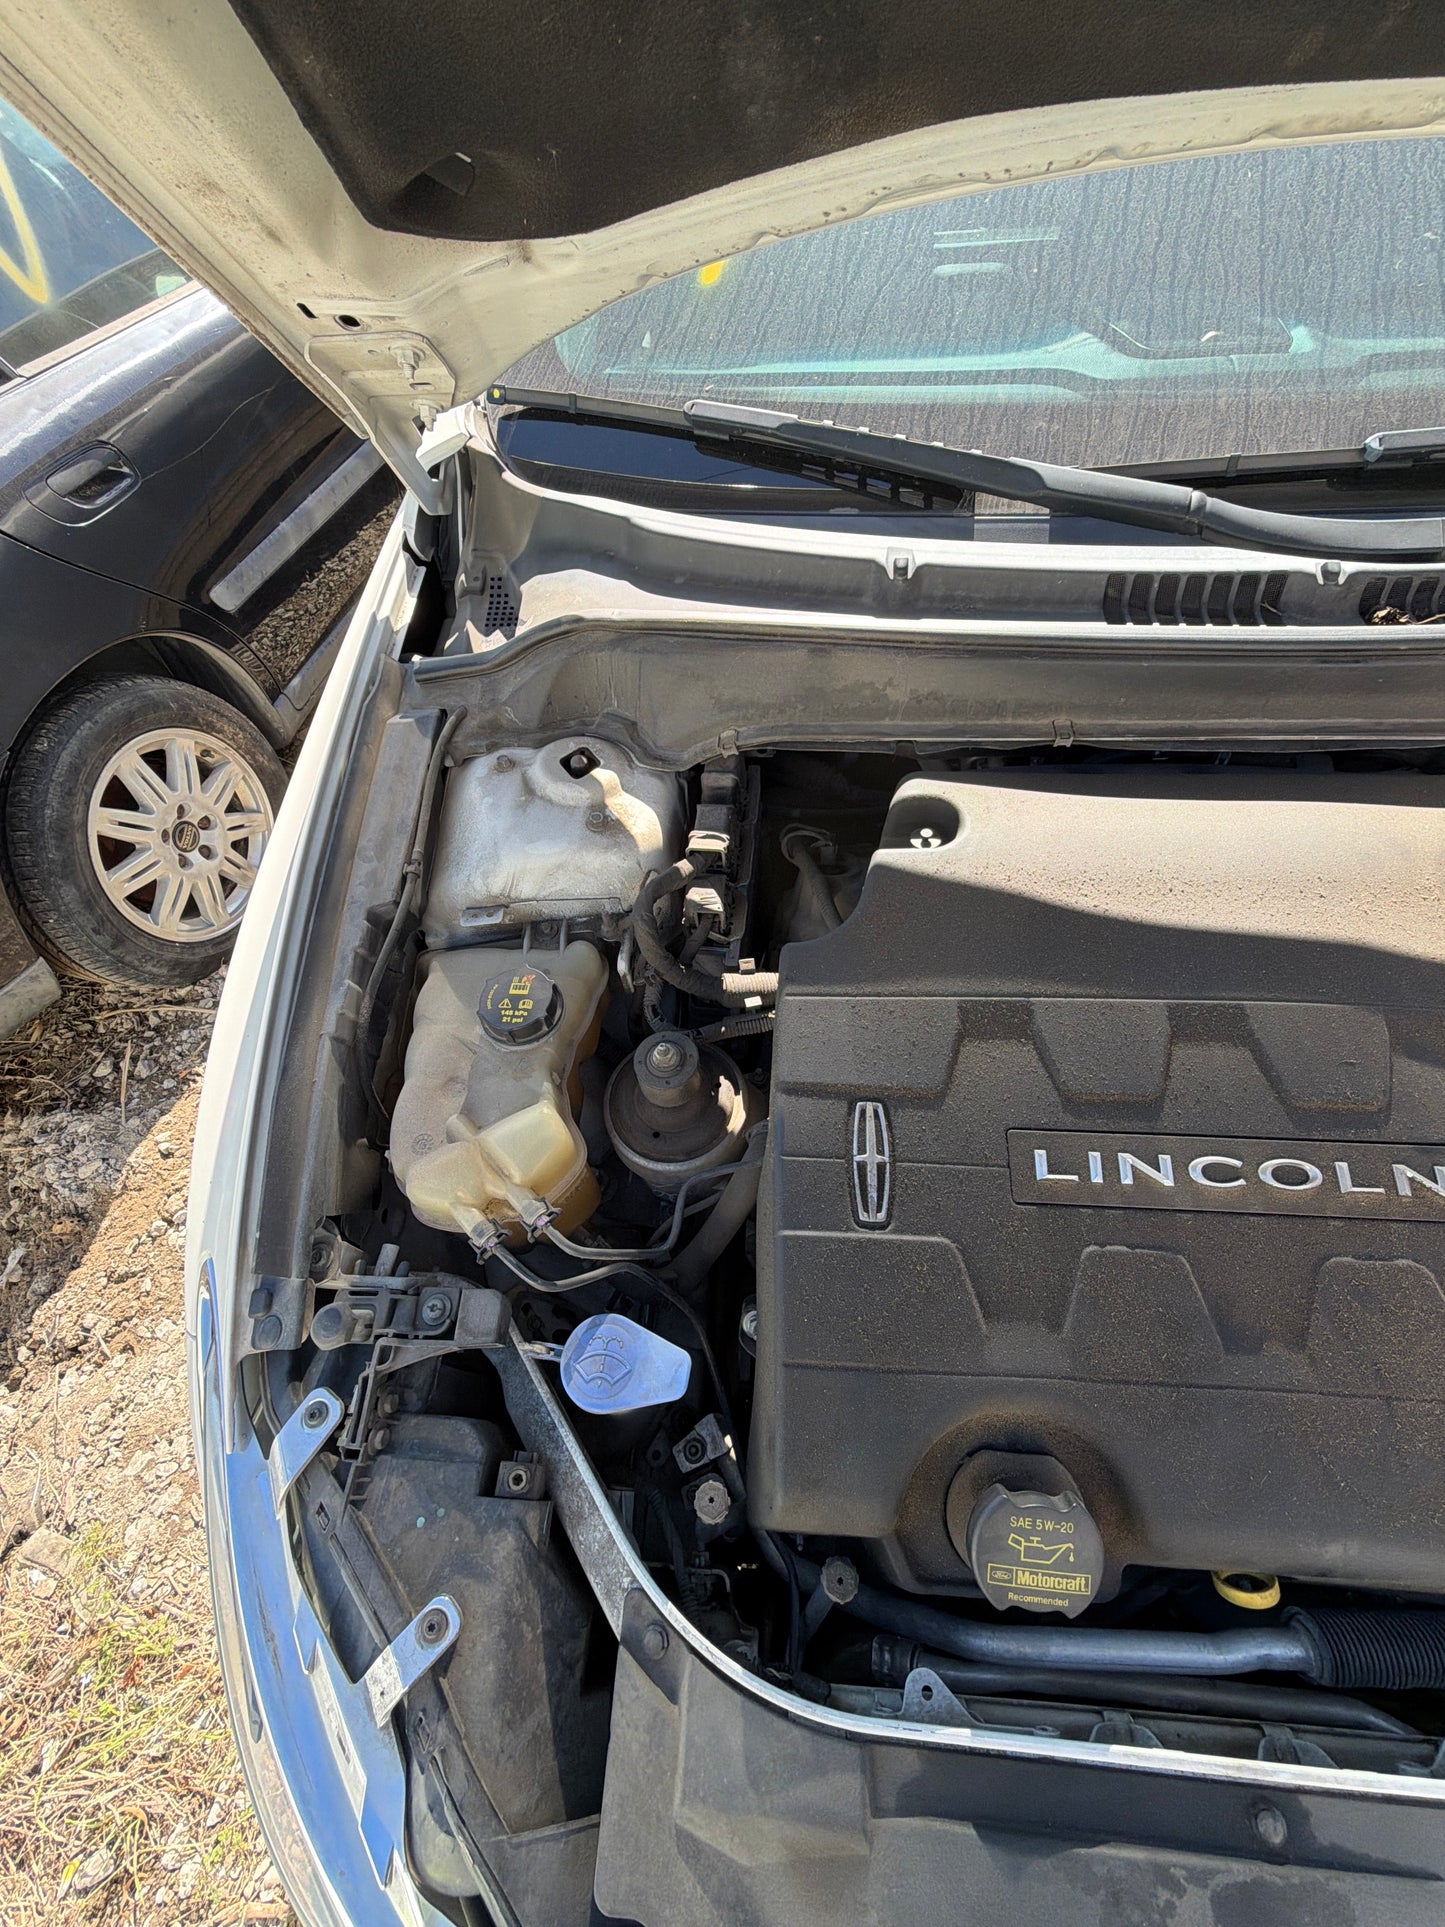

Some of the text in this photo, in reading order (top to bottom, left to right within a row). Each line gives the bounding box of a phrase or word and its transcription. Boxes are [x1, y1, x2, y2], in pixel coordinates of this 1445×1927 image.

[1033, 1149, 1445, 1197] LINCOLN
[1009, 1516, 1032, 1530] SAE
[1017, 1570, 1087, 1592] Motorcraft
[1008, 1593, 1069, 1607] Recommended
